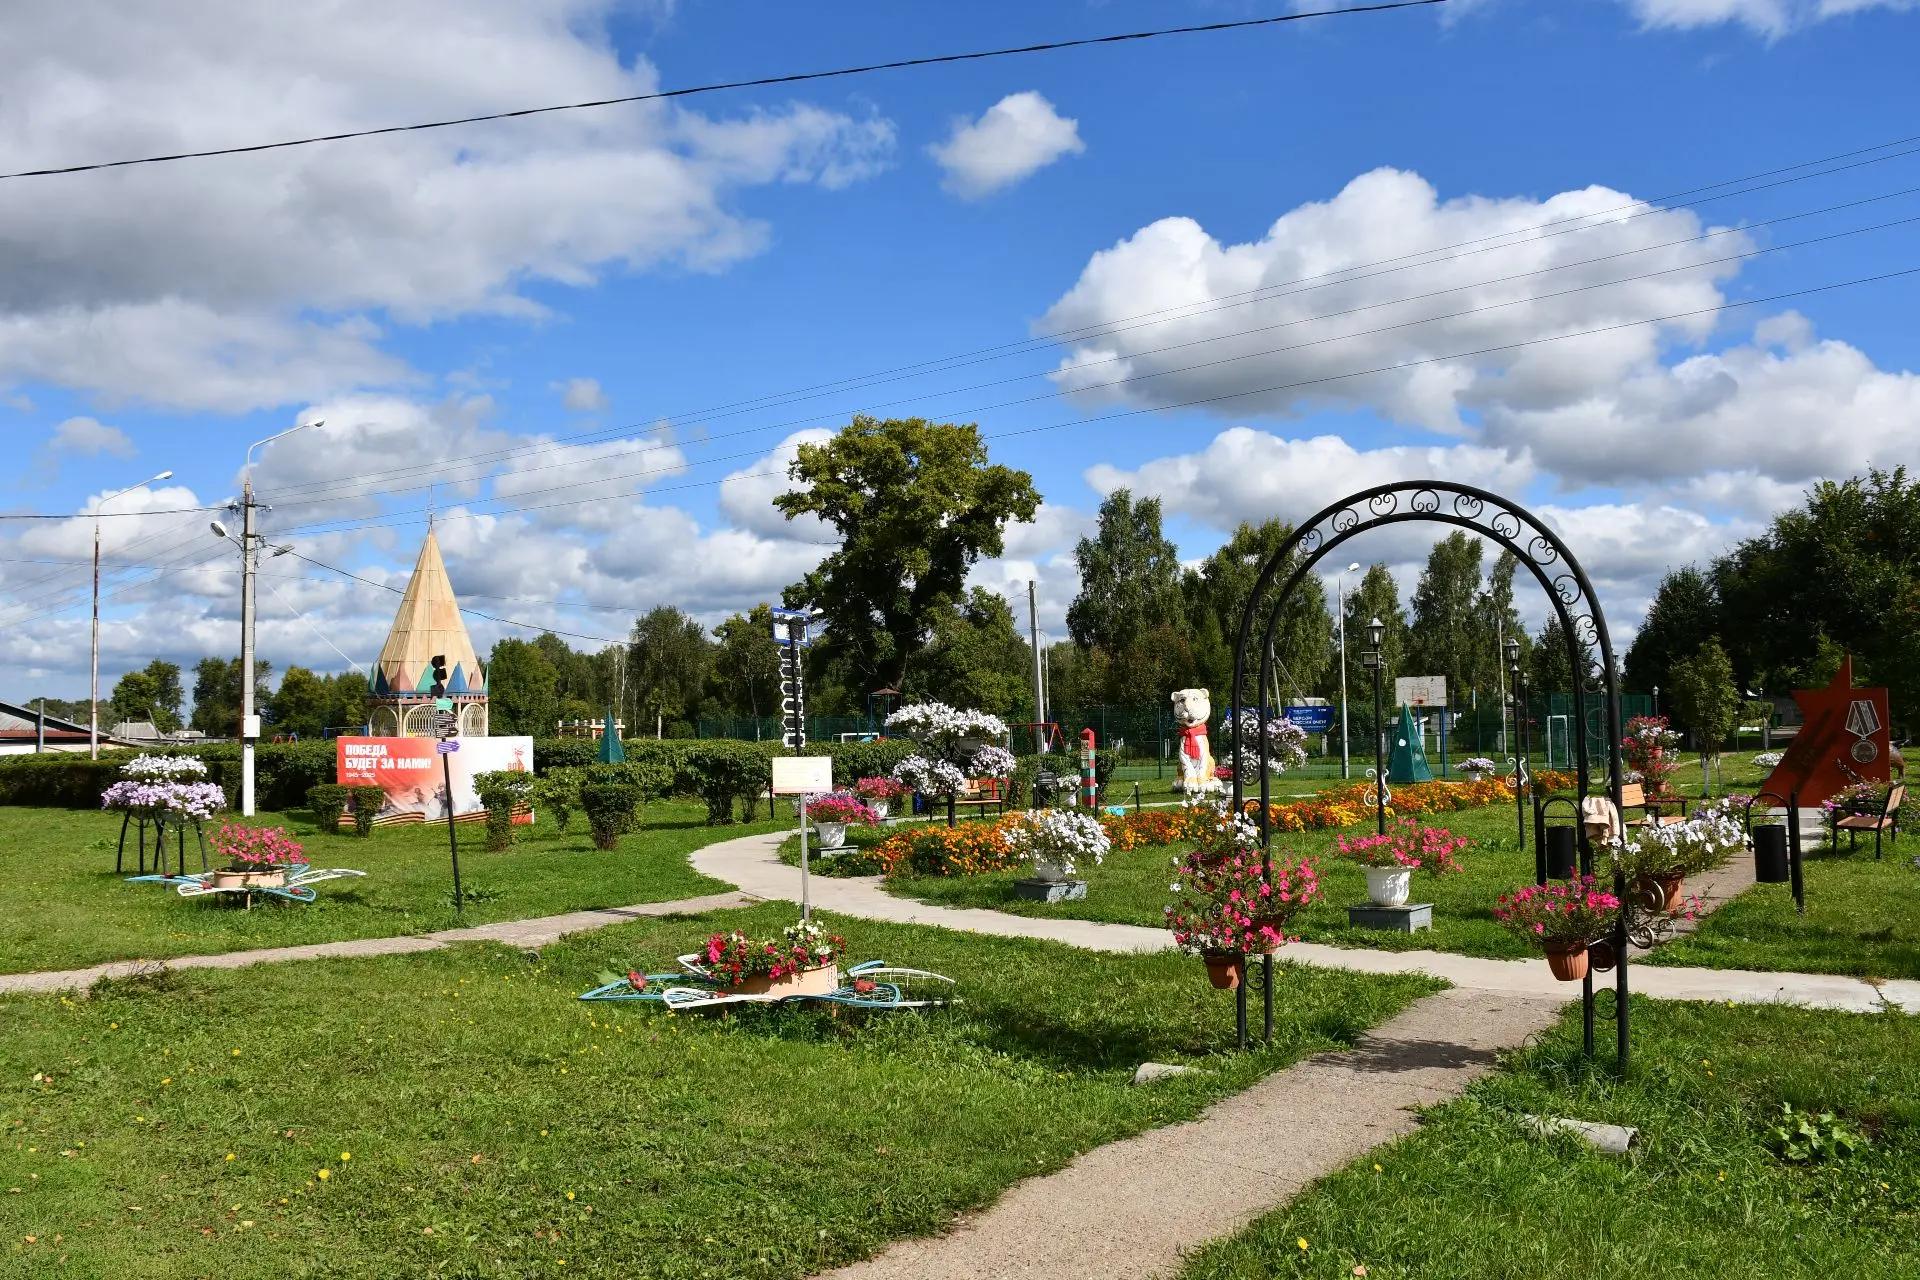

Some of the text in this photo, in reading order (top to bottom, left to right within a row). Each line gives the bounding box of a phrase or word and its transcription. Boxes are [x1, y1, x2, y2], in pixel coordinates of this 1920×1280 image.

[345, 744, 387, 756] ПОБЕДА
[345, 758, 431, 770] БУДЕТ ЗА НАМИ!
